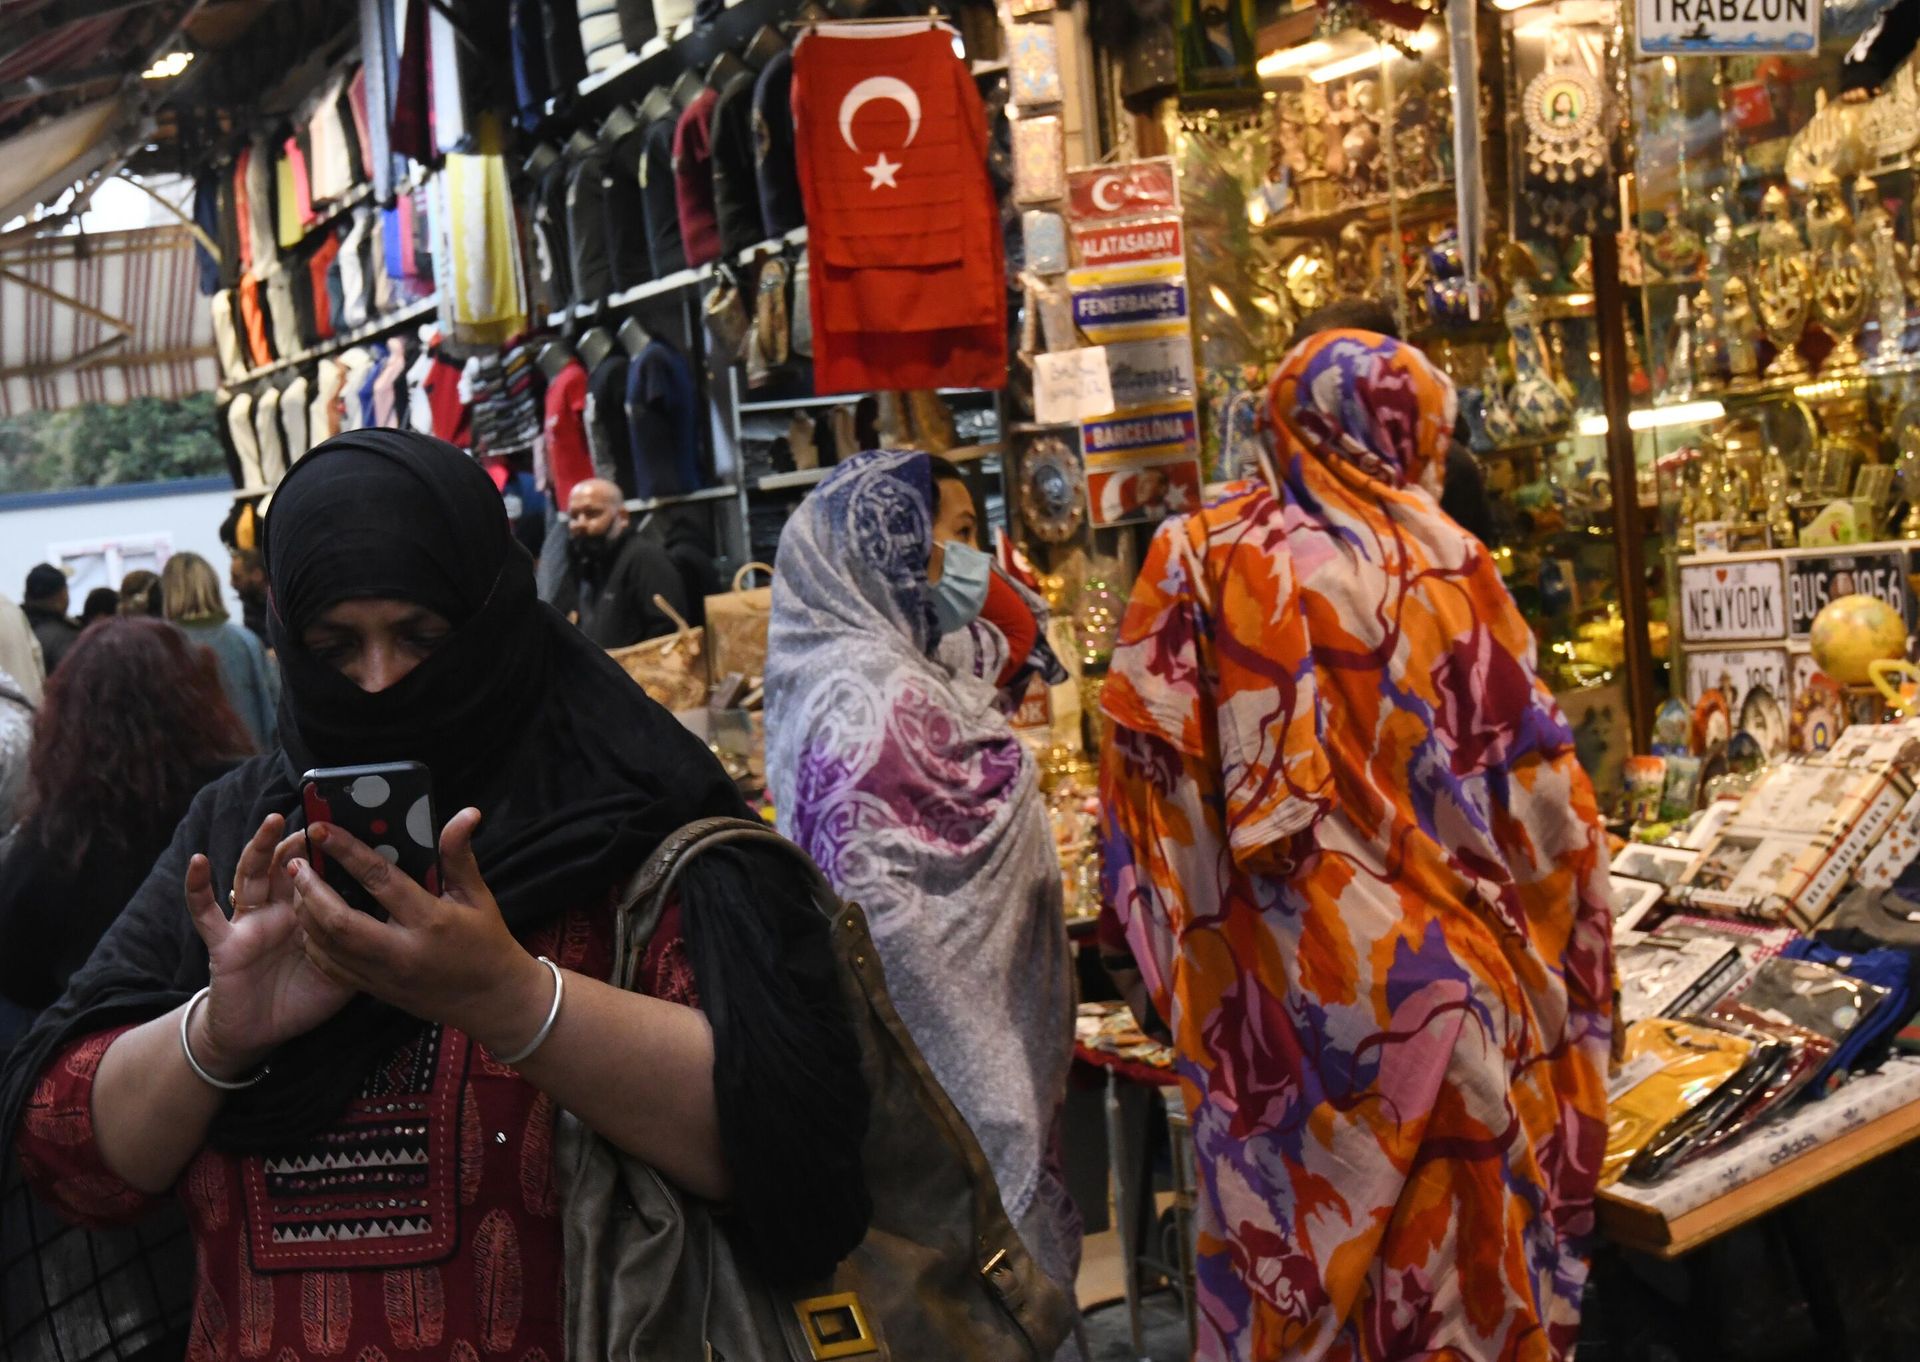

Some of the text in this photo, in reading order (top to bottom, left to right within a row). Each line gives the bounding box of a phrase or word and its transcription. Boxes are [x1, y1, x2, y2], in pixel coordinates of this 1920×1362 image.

[1655, 0, 1806, 22] TRABZON
[1082, 229, 1175, 257] ALATASARAY
[1790, 572, 1829, 620] BUS
